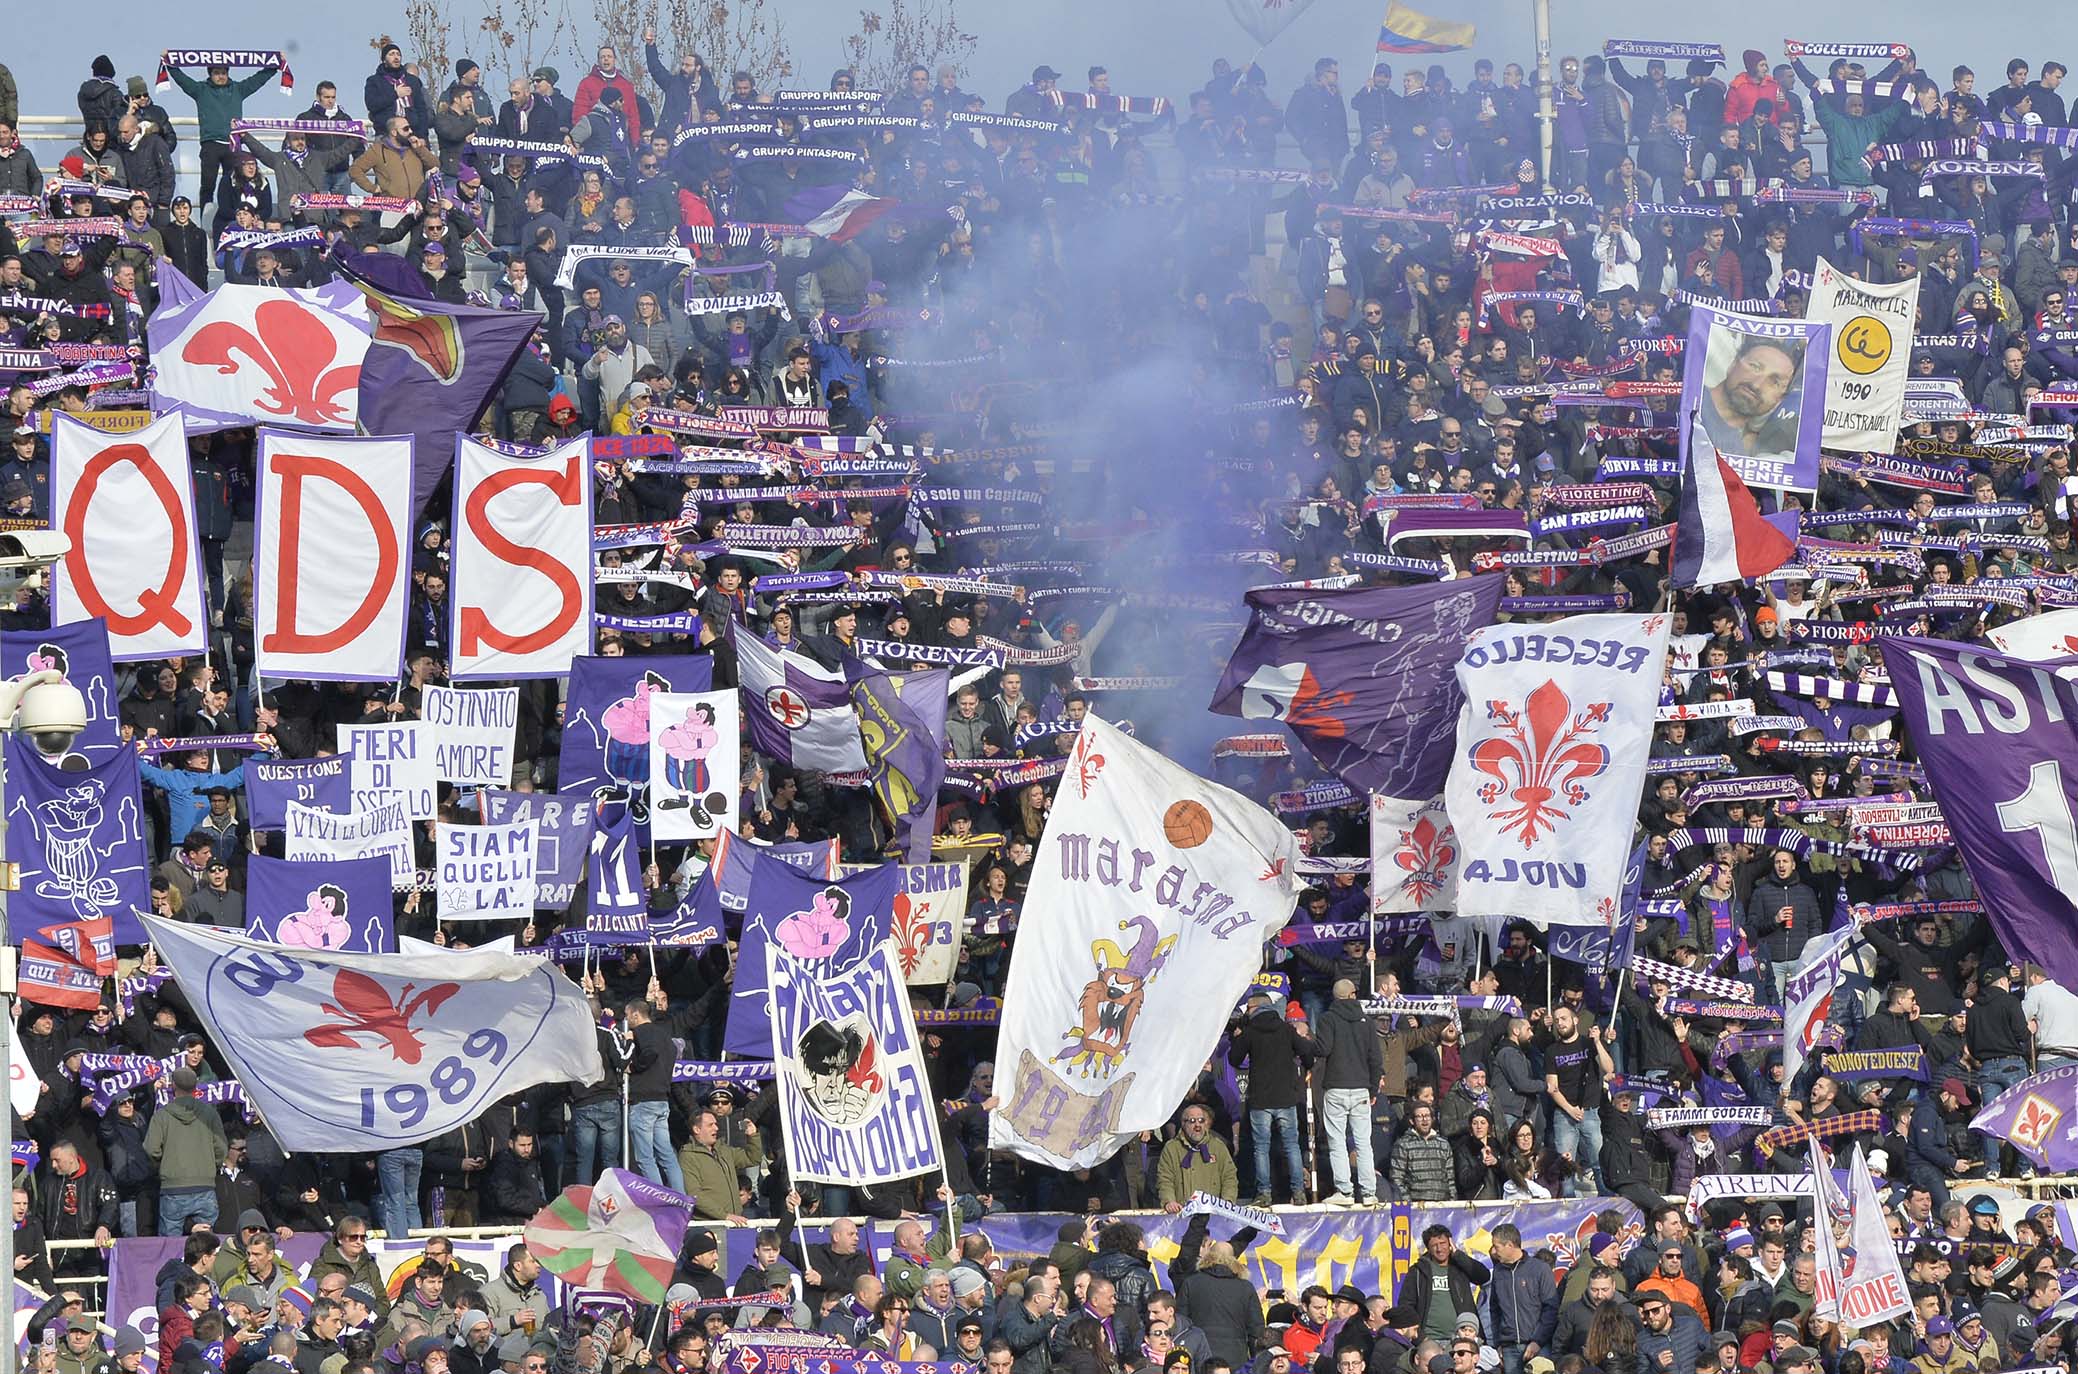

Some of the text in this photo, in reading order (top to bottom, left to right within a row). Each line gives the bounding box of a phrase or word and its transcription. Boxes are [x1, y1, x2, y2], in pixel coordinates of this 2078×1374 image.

[167, 50, 280, 67] FIORENTINA
[1804, 43, 1888, 57] COLLETTIVO
[780, 91, 883, 102] GRUPPO PINTASPORT
[813, 117, 918, 128] GRUPPO PINTASPORT
[952, 112, 1059, 132] GRUPPO PINTASPORT
[471, 137, 512, 151] GRUPPO
[673, 124, 773, 147] GRUPPO PINTASPORT
[752, 147, 857, 162] GRUPPO PINTASPORT
[1640, 204, 1717, 218] Firenze
[1, 296, 75, 316] ENTINA
[702, 293, 777, 312] COLLETTIVO
[1714, 313, 1806, 336] DAVIDE
[1961, 335, 1978, 348] 73
[54, 346, 126, 360] FIORENTINA
[33, 370, 98, 389] FIORENTINA
[1841, 382, 1872, 400] 1990
[651, 413, 752, 434] ALE FIORENTINA
[630, 434, 672, 452] 1926
[649, 462, 757, 474] ACF FIORENTINA
[804, 457, 822, 475] 13
[822, 459, 852, 472] CIAO
[1876, 455, 1964, 484] FIORENTINA
[931, 488, 961, 501] solo
[964, 488, 981, 500] un
[1562, 486, 1642, 499] FIORENTINA
[1540, 506, 1646, 531] SAN FREDIANO
[1812, 510, 1903, 525] FIORENTINA
[1930, 504, 2029, 519] ACF FIORENTINA
[64, 443, 192, 637] Q
[723, 526, 860, 541] COLLETTIVO VIOLA
[1605, 528, 1667, 554] FIORENTINA
[263, 453, 399, 654] D
[460, 456, 582, 657] S
[1353, 553, 1438, 571] FIORENTINA
[1502, 550, 1578, 564] COLLETTIVO
[768, 573, 831, 587] FIORENTINA
[1818, 572, 1856, 581] Fiorentina
[2002, 577, 2075, 588] FIORENTINA
[1940, 584, 2021, 600] FIORENTINA
[1895, 601, 1928, 611] QUARTIERI,
[1933, 600, 1955, 608] CUORE
[1811, 624, 1903, 640] FIORENTINA
[861, 639, 1006, 669] FIORENZA
[426, 689, 516, 729] OSTINATO
[180, 734, 248, 746] Fiorentina
[351, 729, 416, 761] FIERI
[1778, 740, 1878, 753] FIORENTINA
[258, 759, 343, 781] QUESTIONE
[436, 744, 503, 779] AMORE
[372, 764, 392, 788] DI
[1002, 764, 1056, 785] Fiorentina
[297, 785, 315, 801] DI
[291, 801, 408, 841] VIVI LA CURVA
[491, 797, 590, 830] FARE
[1876, 824, 1950, 841] FIORENTINA
[450, 828, 530, 859] SIAM
[443, 858, 531, 884] QUELLI
[1057, 832, 1256, 940] marasma
[1313, 921, 1365, 939] PAZZI
[101, 1068, 141, 1097] QUI
[361, 1028, 508, 1129] 1989
[1665, 1107, 1759, 1122] FAMMI GODERE
[1702, 1174, 1814, 1195] FIRENZ
[1201, 1195, 1269, 1224] COLLETTIVO
